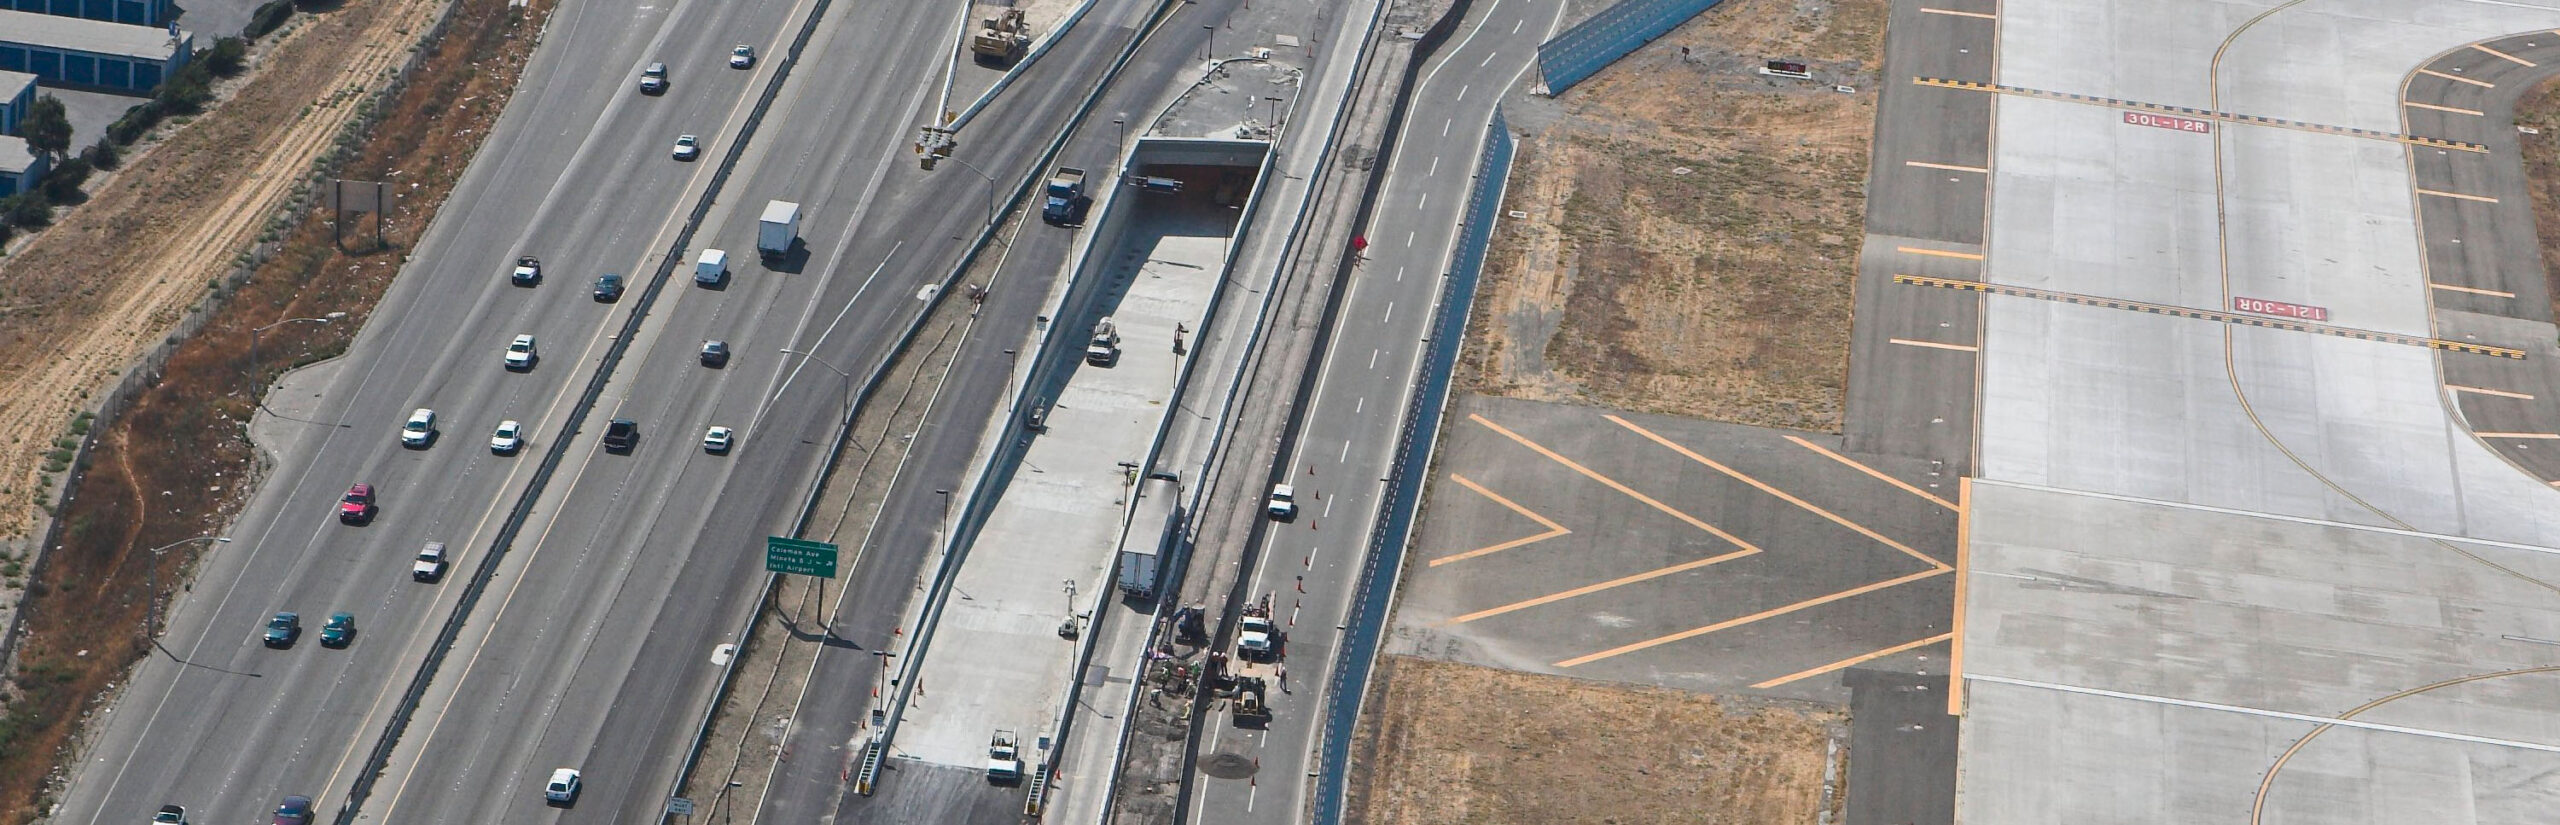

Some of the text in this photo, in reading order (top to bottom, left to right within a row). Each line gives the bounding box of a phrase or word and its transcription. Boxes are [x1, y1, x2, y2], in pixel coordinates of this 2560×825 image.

[2129, 114, 2205, 132] 30L-12R
[2240, 299, 2321, 319] 12L-30R
[771, 546, 803, 555] Coleman
[787, 565, 815, 573] Airport
